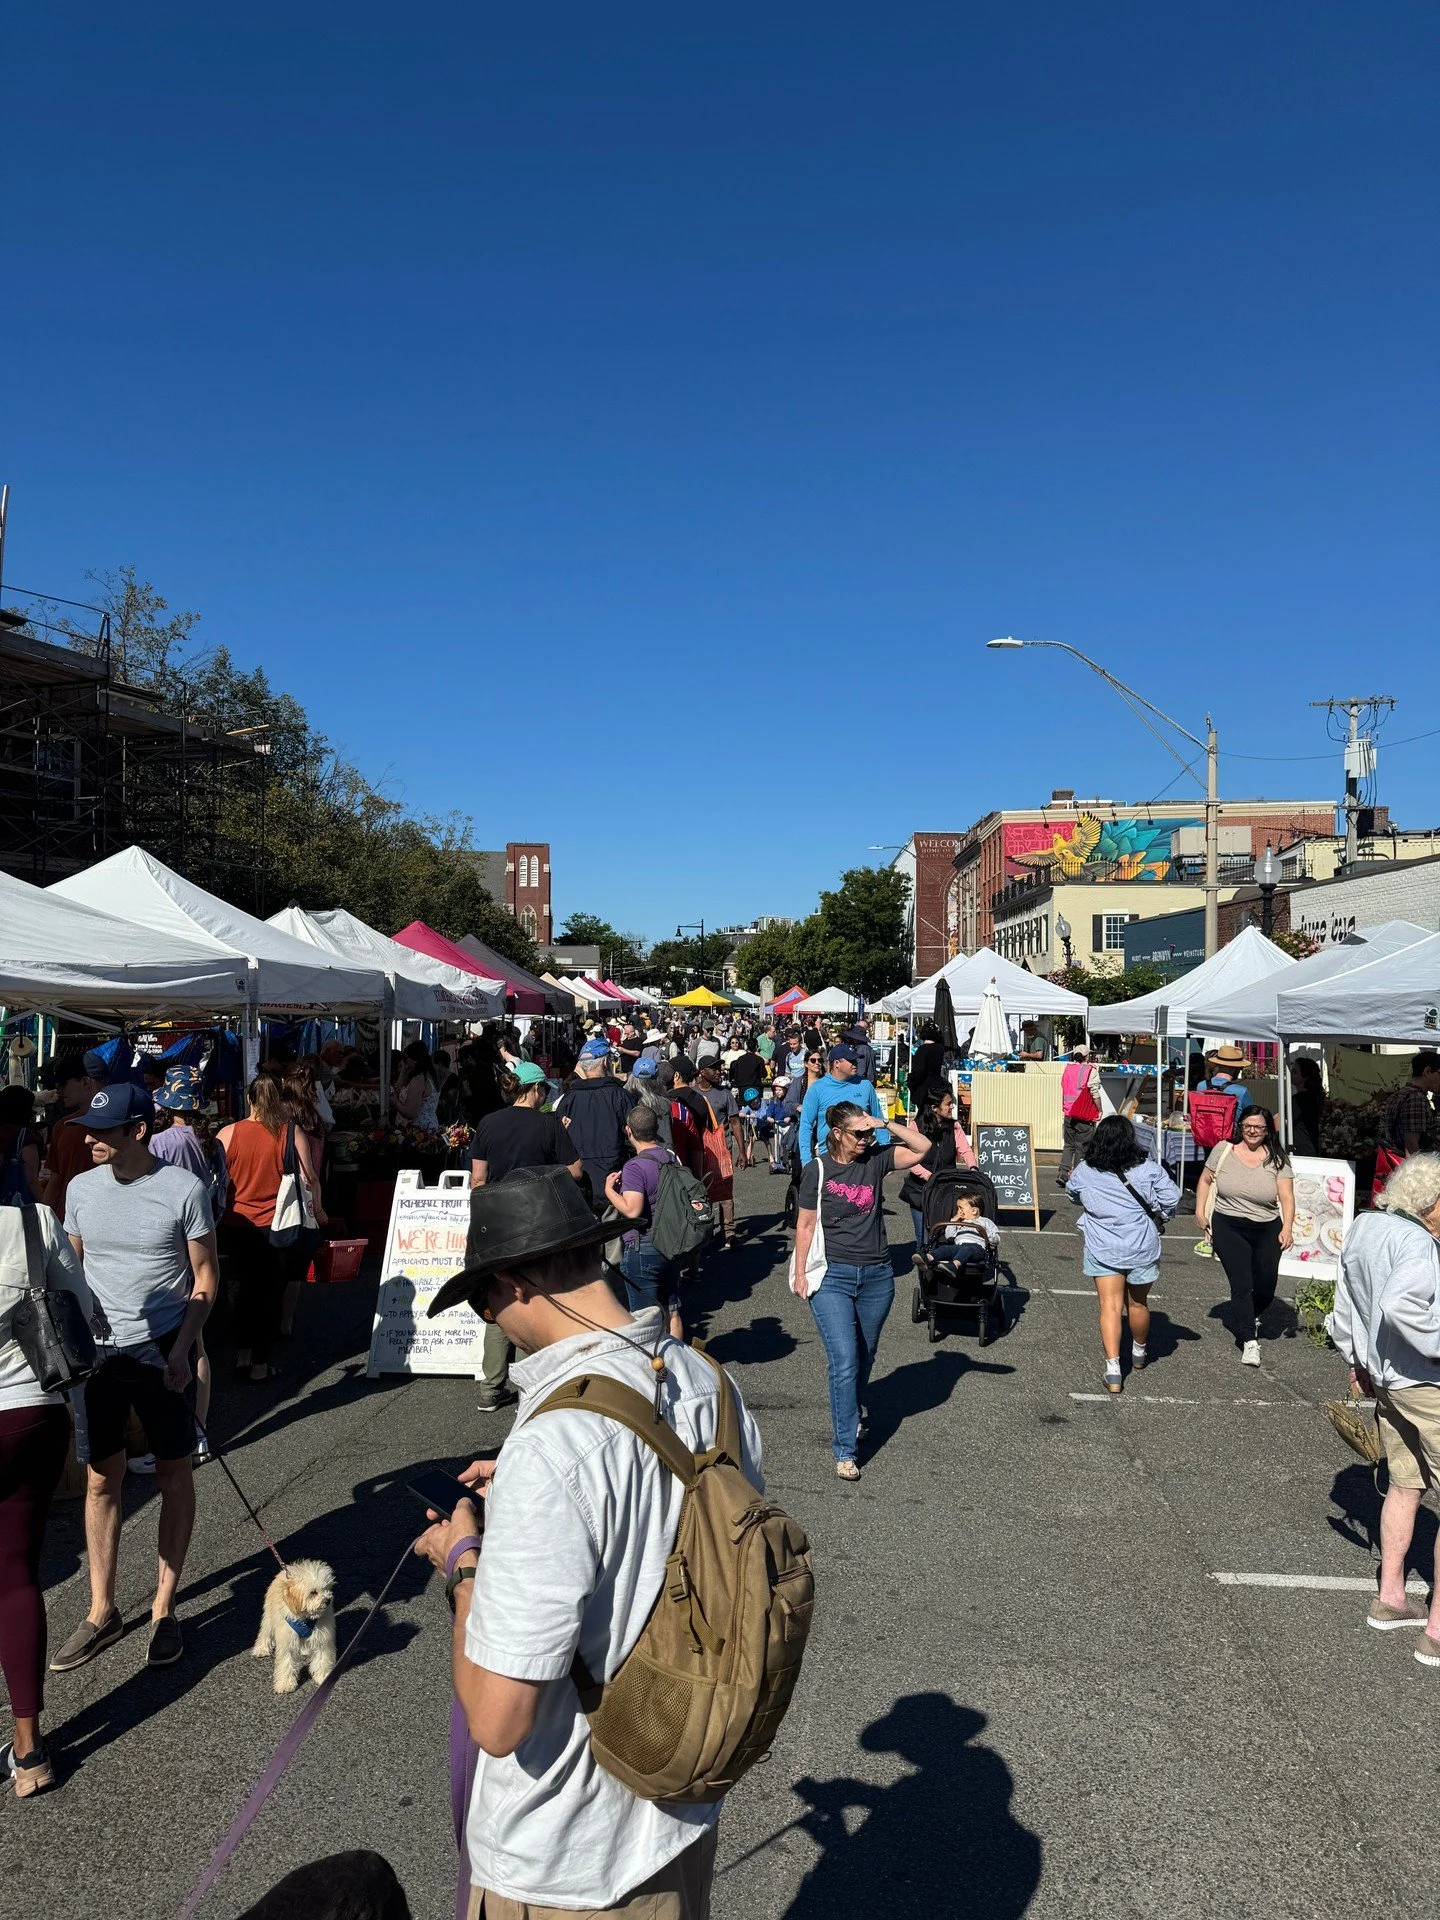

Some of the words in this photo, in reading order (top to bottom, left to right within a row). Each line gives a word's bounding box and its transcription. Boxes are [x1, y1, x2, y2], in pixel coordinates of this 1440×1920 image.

[979, 1131, 1011, 1149] Farm
[445, 1230, 468, 1251] HIR
[431, 1257, 453, 1266] MUST
[386, 1329, 394, 1338] IF
[395, 1329, 406, 1338] YOU
[421, 1338, 430, 1346] TO
[430, 1337, 445, 1346] ASK
[446, 1338, 454, 1346] A
[454, 1337, 474, 1346] STAFF
[397, 1345, 433, 1355] MEMBER!
